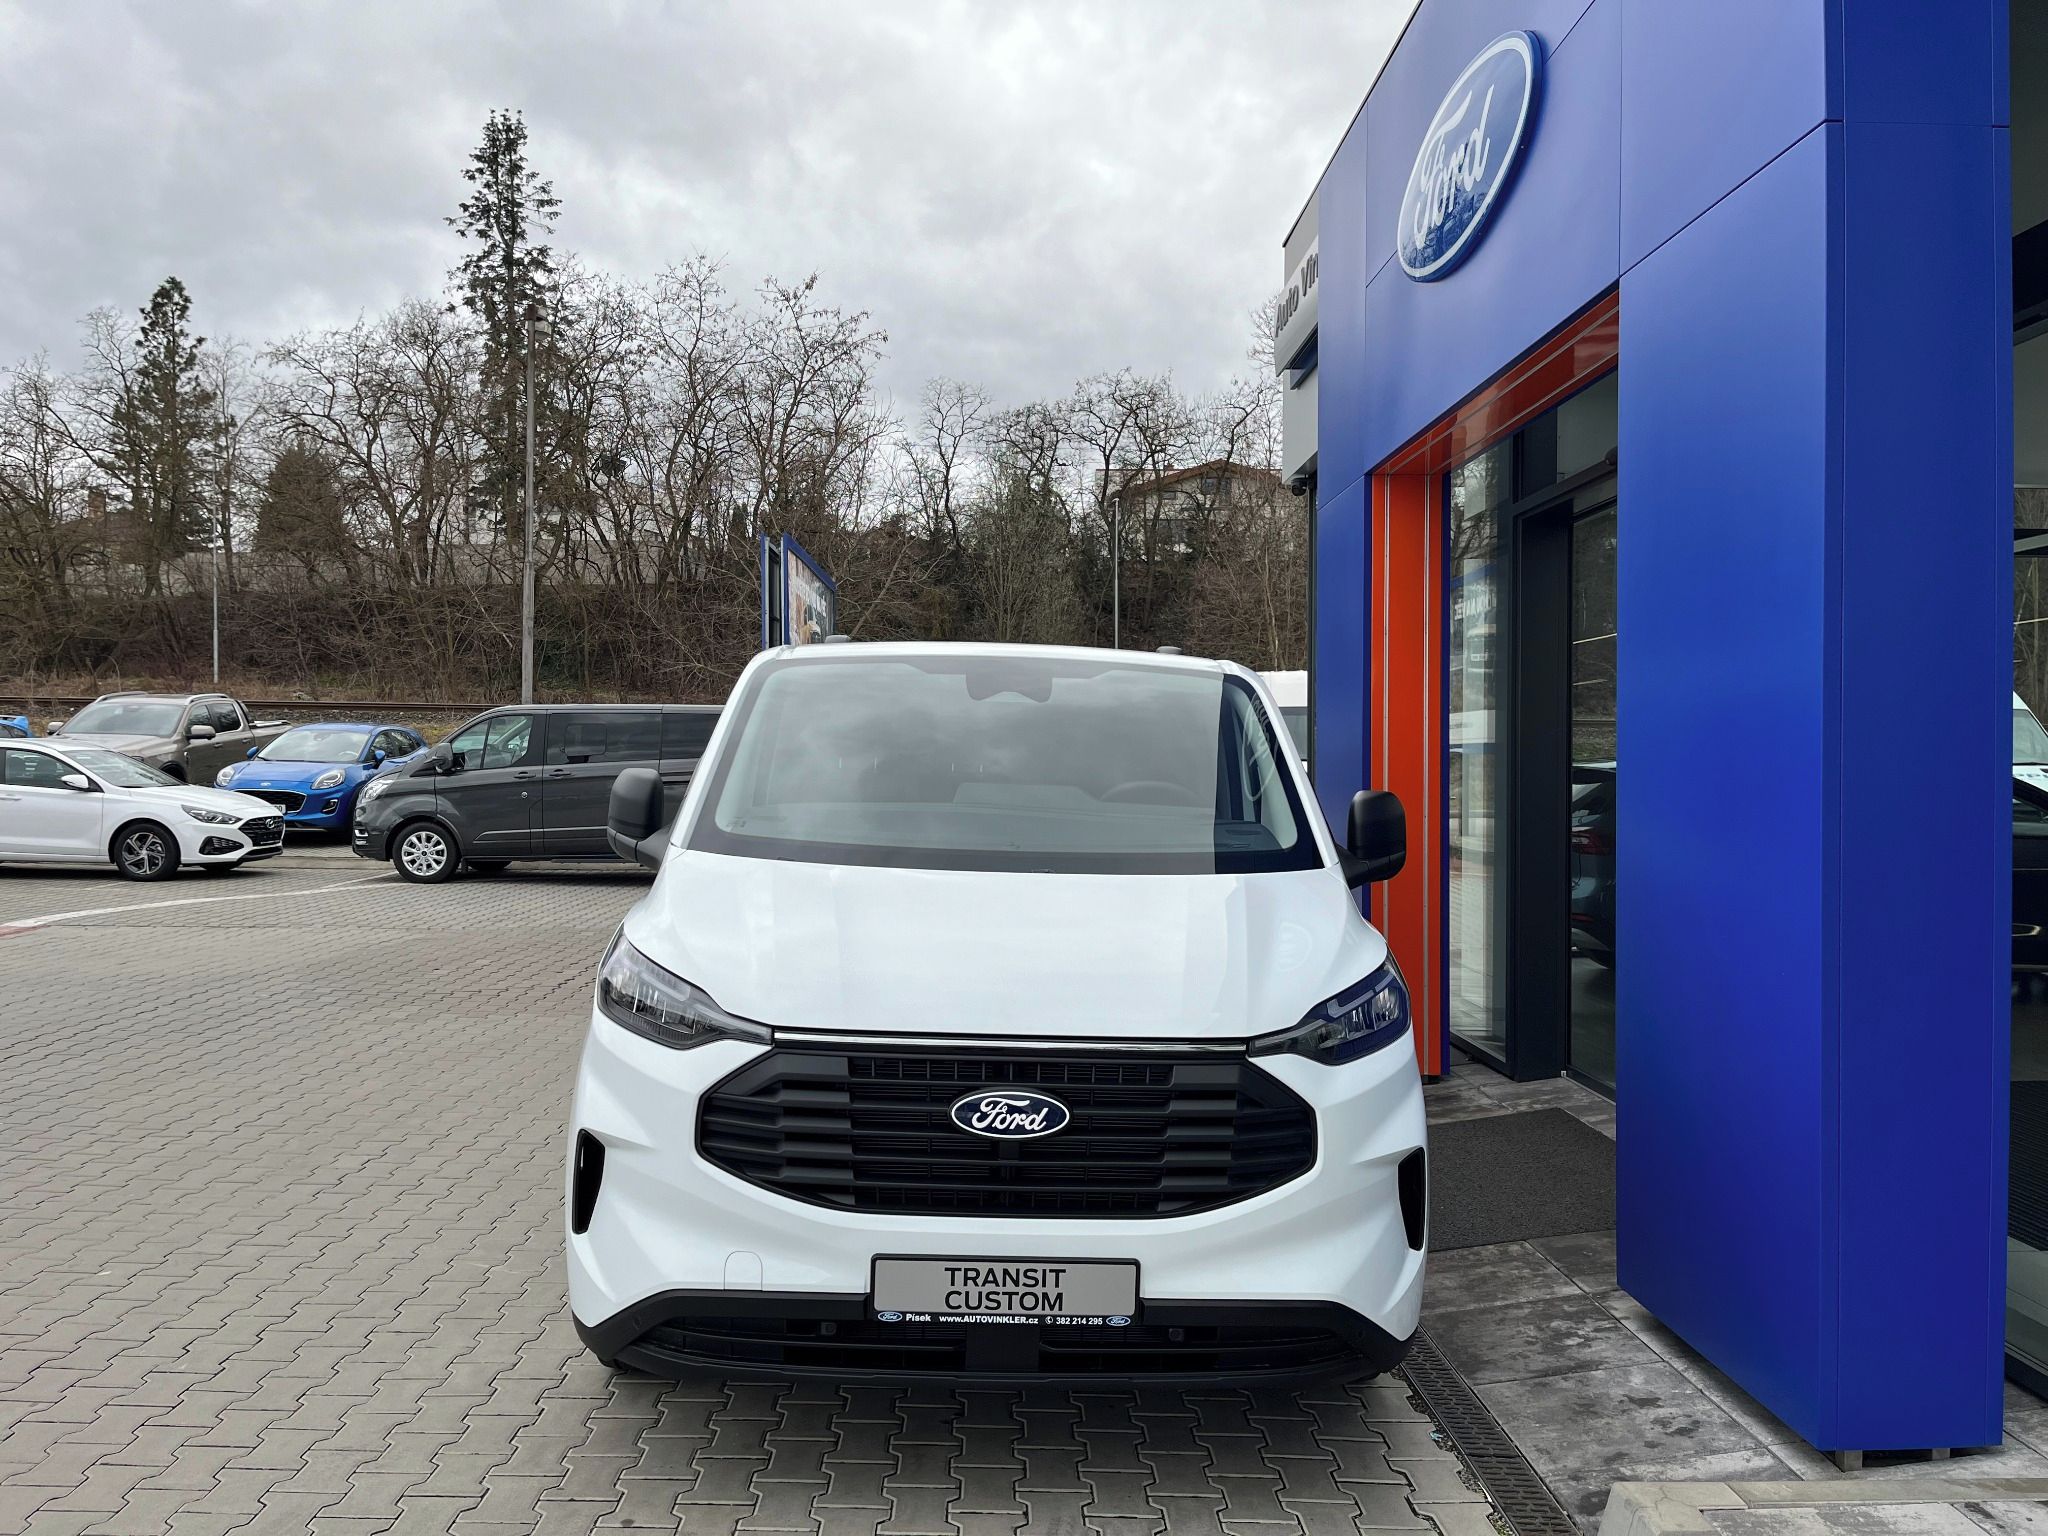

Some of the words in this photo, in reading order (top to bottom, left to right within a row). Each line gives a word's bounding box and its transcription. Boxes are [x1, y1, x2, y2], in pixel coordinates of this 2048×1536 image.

[1414, 83, 1494, 250] Ford
[1275, 284, 1299, 338] Auto
[971, 1097, 1049, 1131] Ford
[944, 1267, 1066, 1288] TRANSIT
[944, 1290, 1064, 1311] CUSTOM
[881, 1312, 899, 1320] Ford
[905, 1313, 931, 1322] Písek
[939, 1315, 1039, 1325] www.AUTOVINKLER.cz
[1056, 1317, 1071, 1325] 382
[1072, 1317, 1087, 1325] 214
[1088, 1317, 1103, 1325] 295
[1110, 1317, 1127, 1325] Ford
